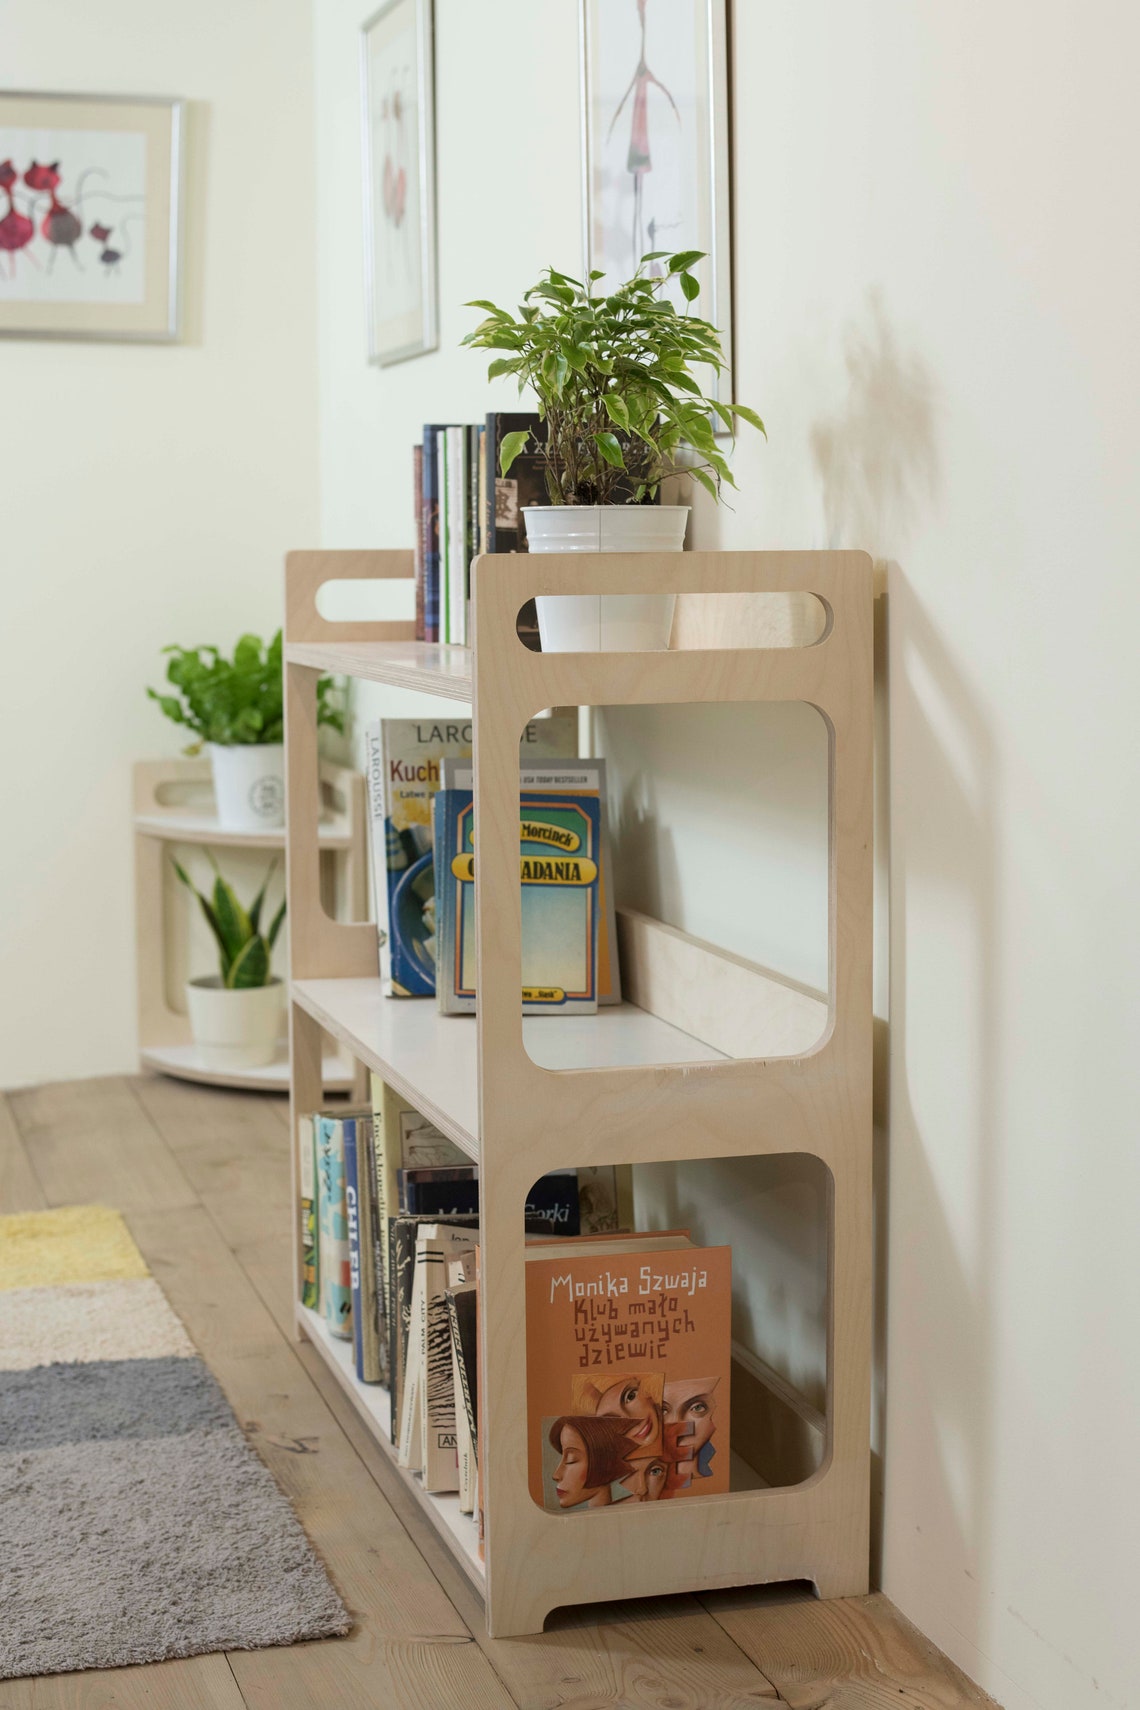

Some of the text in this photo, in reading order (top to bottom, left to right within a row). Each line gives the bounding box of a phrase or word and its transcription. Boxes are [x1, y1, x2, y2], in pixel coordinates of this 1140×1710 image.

[417, 724, 538, 744] LAROE
[370, 737, 383, 821] LAROUSSE
[390, 759, 439, 782] Kuch
[550, 1266, 707, 1304] Monika Szwaja
[574, 1293, 679, 1325] Klub mało
[574, 1309, 695, 1343] używanych
[448, 1302, 477, 1432] MARTIN EDEN
[579, 1340, 667, 1368] dziewic
